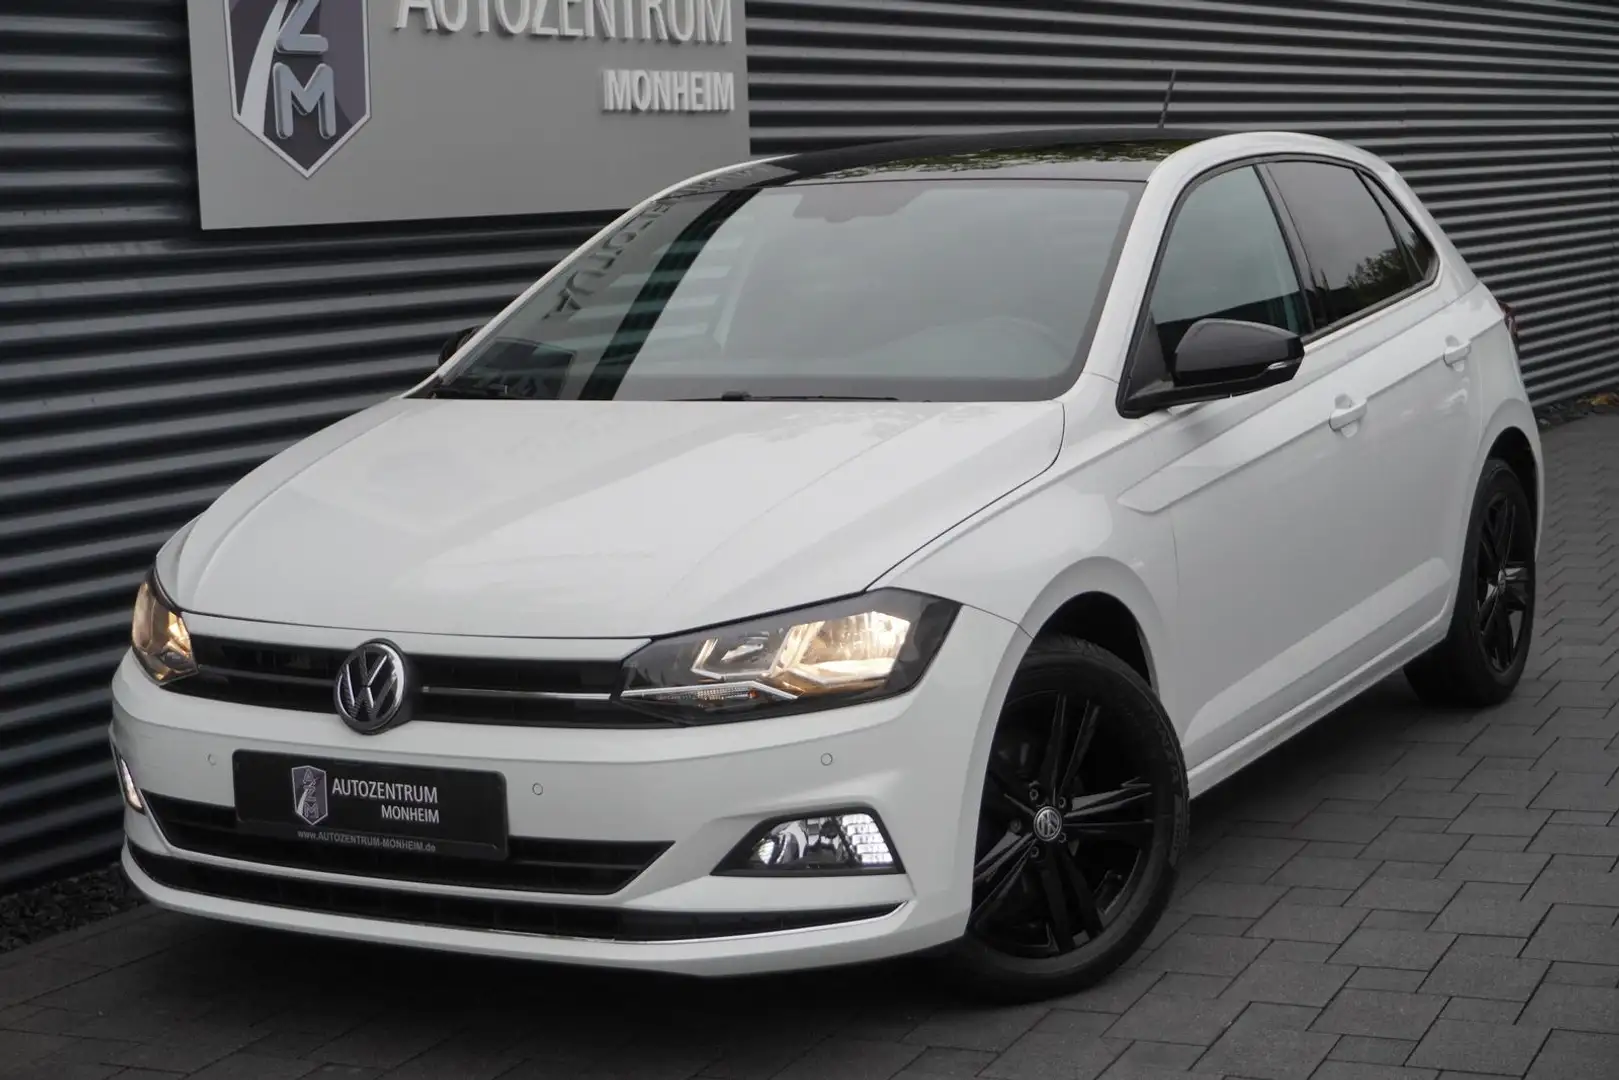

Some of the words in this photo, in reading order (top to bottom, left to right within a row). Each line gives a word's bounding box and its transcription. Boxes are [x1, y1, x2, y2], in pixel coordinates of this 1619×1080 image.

[602, 69, 735, 112] MONHEIM
[331, 777, 438, 804] AUTOZENTRUM
[381, 804, 440, 824] MONHEIM
[297, 830, 436, 852] www.AUTOZENTRUM-MONHEIM.de
